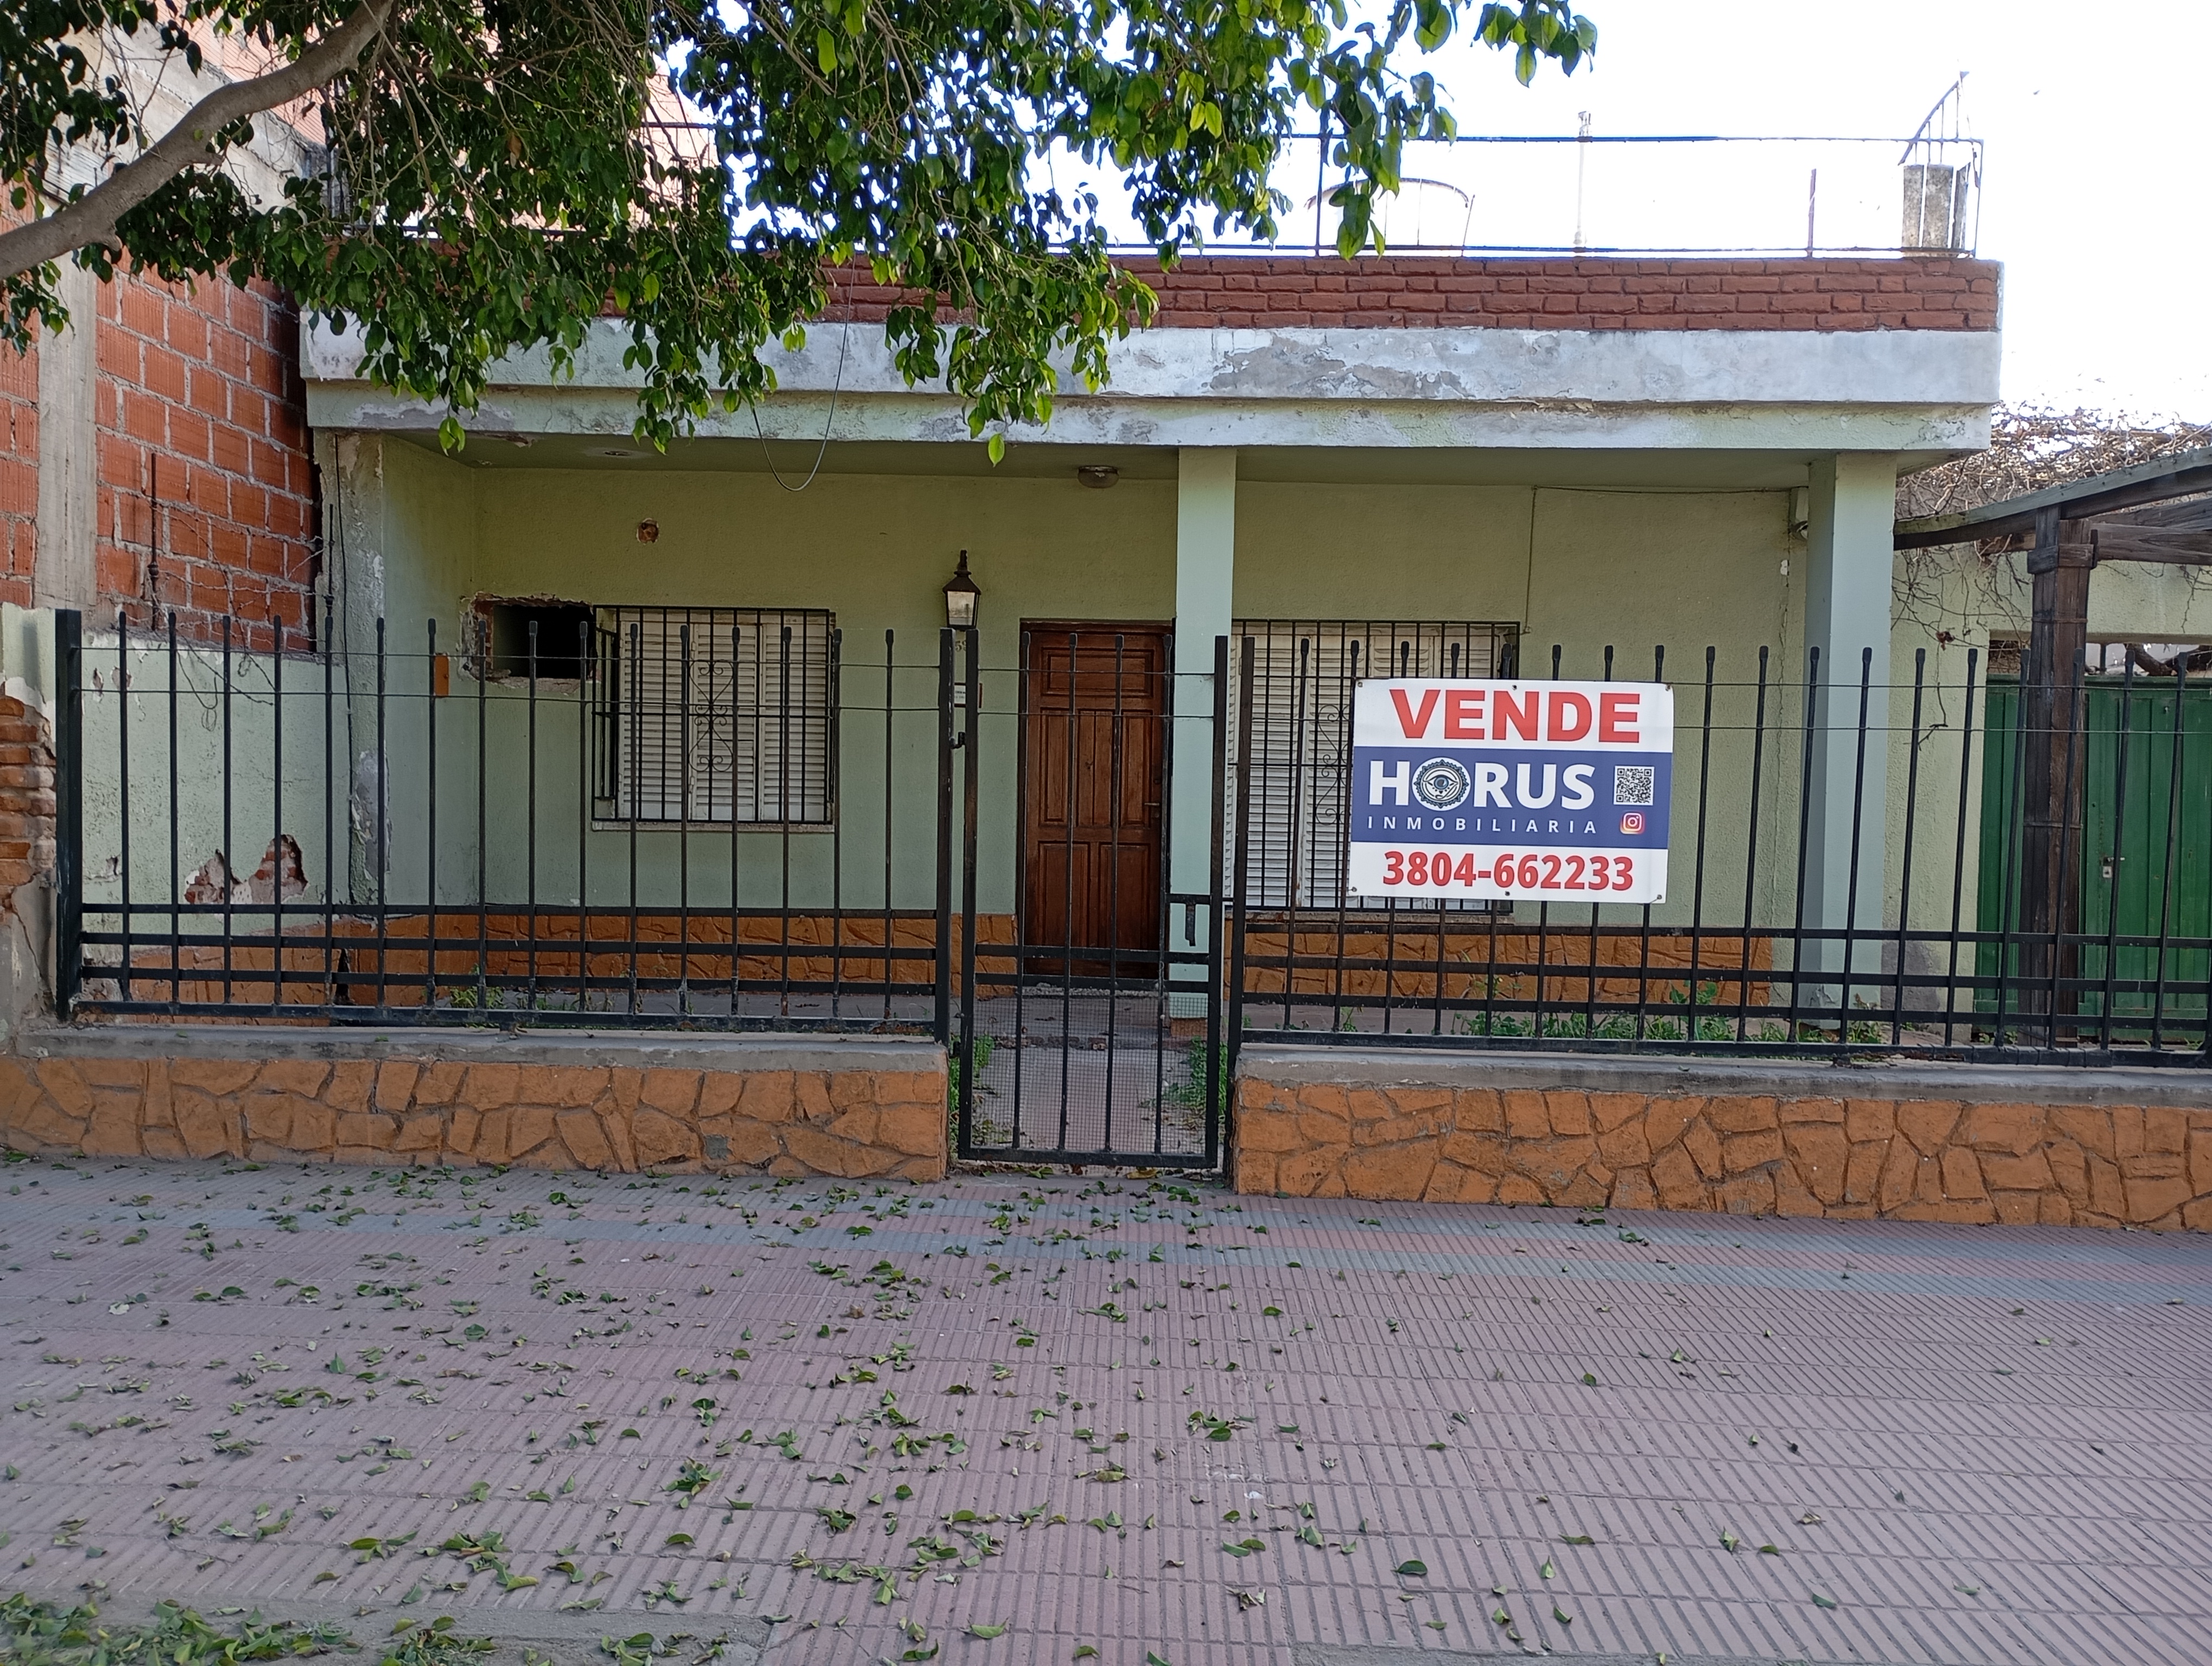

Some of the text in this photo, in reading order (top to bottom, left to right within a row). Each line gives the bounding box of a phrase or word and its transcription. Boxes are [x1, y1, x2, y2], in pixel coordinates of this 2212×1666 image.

[1390, 689, 1641, 744] VENDE
[1368, 757, 1596, 811] HORUS
[1367, 816, 1597, 834] INMOBILIARIA
[1382, 850, 1634, 891] 3804-662233
